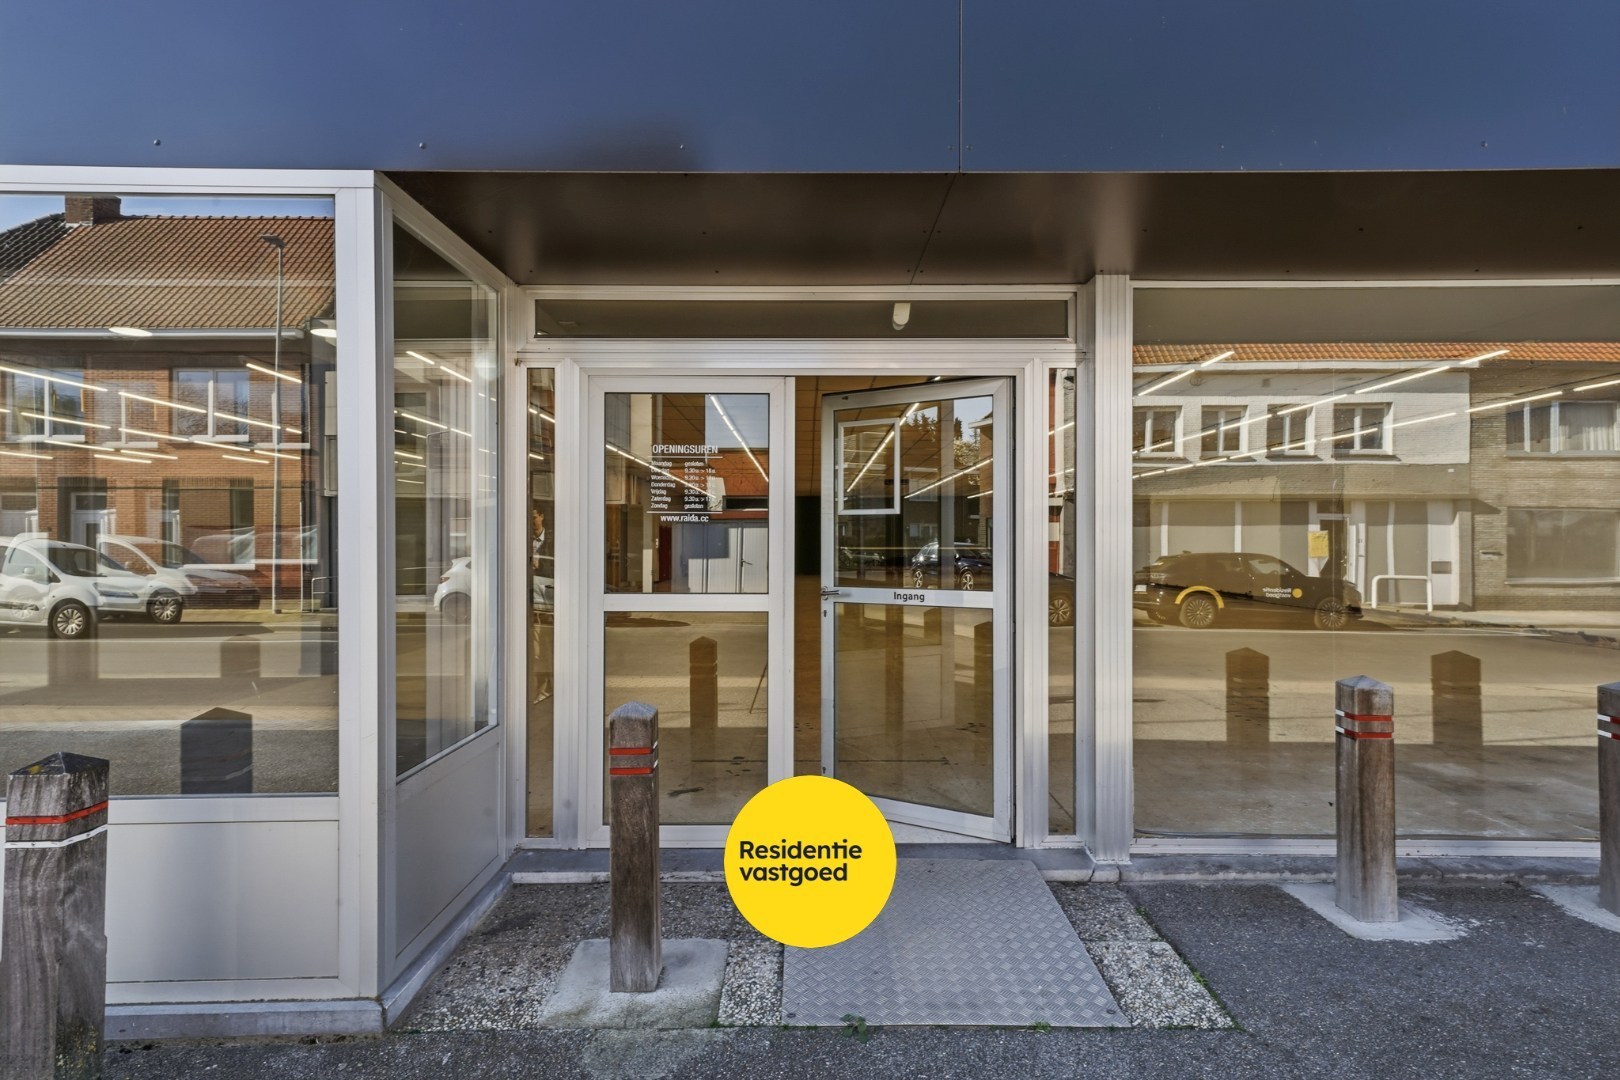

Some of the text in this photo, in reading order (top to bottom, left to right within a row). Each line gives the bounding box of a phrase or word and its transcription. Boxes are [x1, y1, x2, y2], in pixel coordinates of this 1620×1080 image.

[652, 444, 719, 454] OPENINGSUREN
[651, 460, 673, 468] Maandag
[660, 513, 709, 522] www.raida.cc
[893, 591, 925, 603] Ingang
